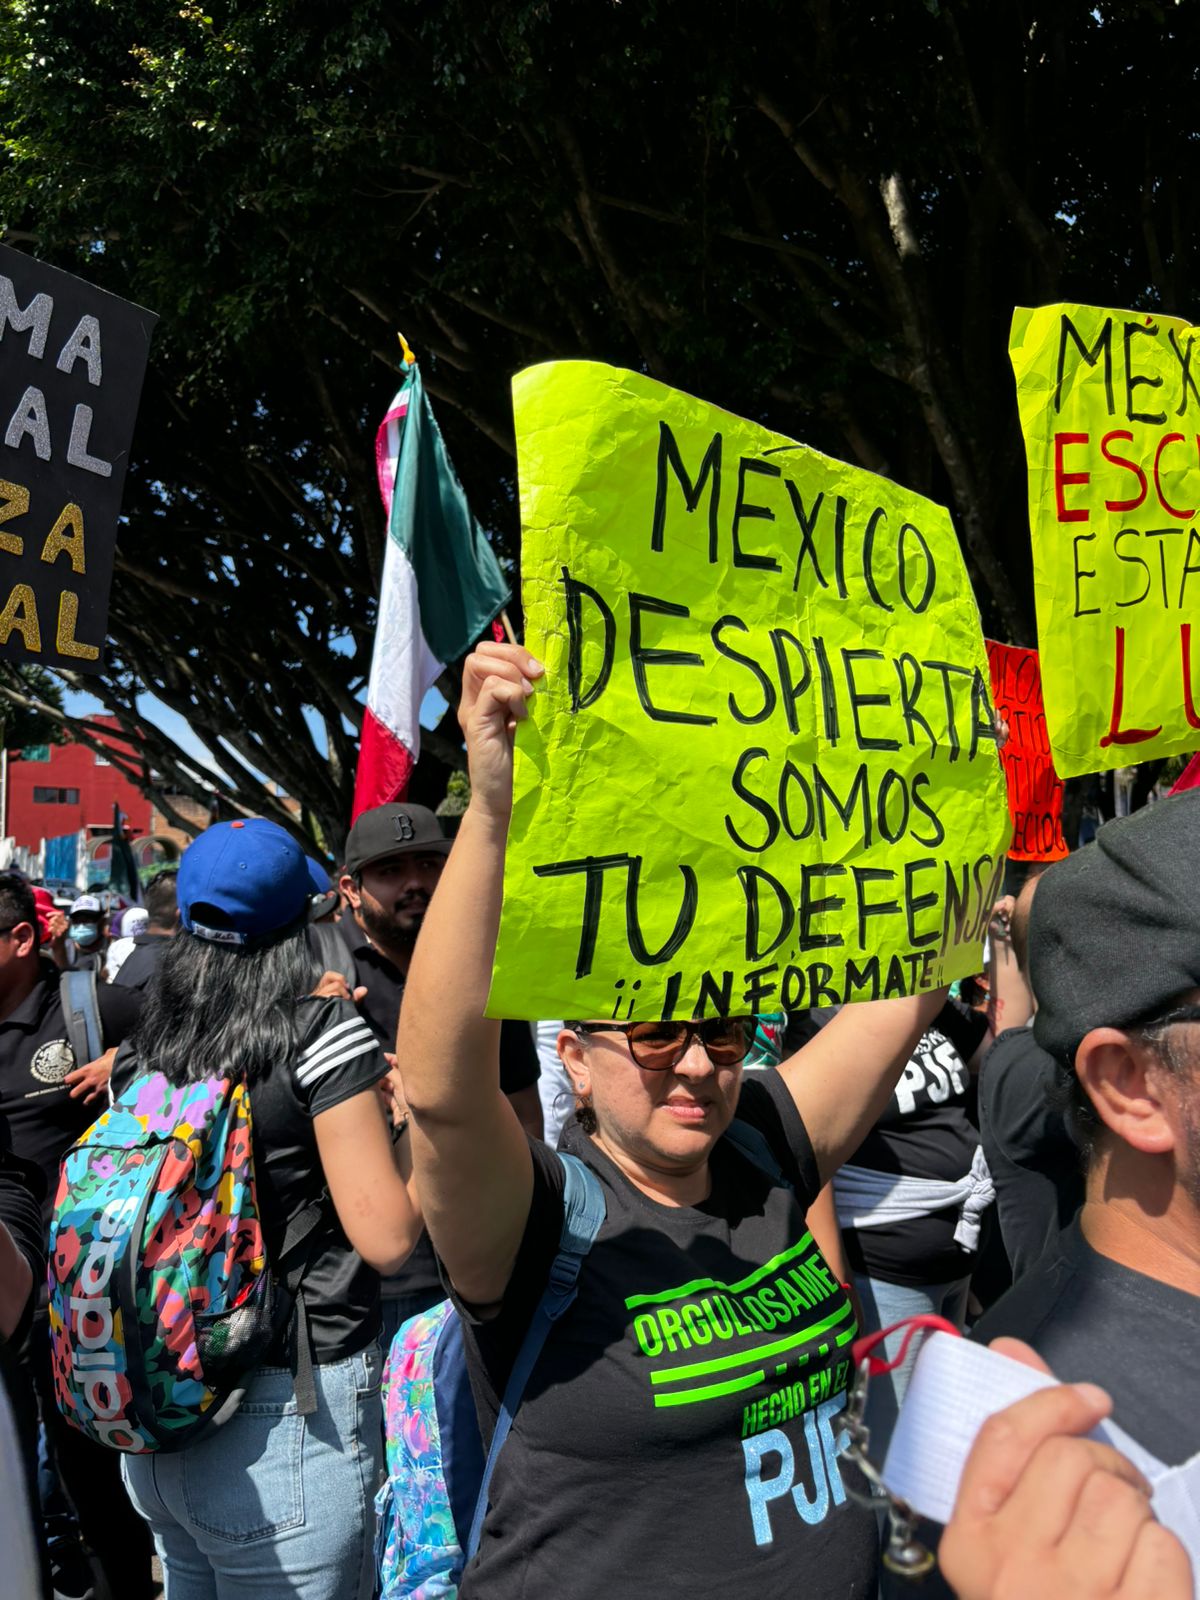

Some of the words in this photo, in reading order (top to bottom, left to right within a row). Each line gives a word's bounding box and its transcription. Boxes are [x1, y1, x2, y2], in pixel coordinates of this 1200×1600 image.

[0, 275, 103, 386] MA
[5, 385, 112, 477] AL
[1055, 429, 1200, 523] ESC
[651, 420, 937, 614] MÉXICO
[0, 583, 100, 660] AL
[558, 566, 998, 763] DESPIERTA
[725, 747, 945, 853] SOMOS
[532, 853, 699, 979] TU
[737, 855, 1004, 962] DEFENSA
[70, 1196, 145, 1450] adidas
[741, 1381, 806, 1438] HECHO
[809, 1367, 832, 1408] EN
